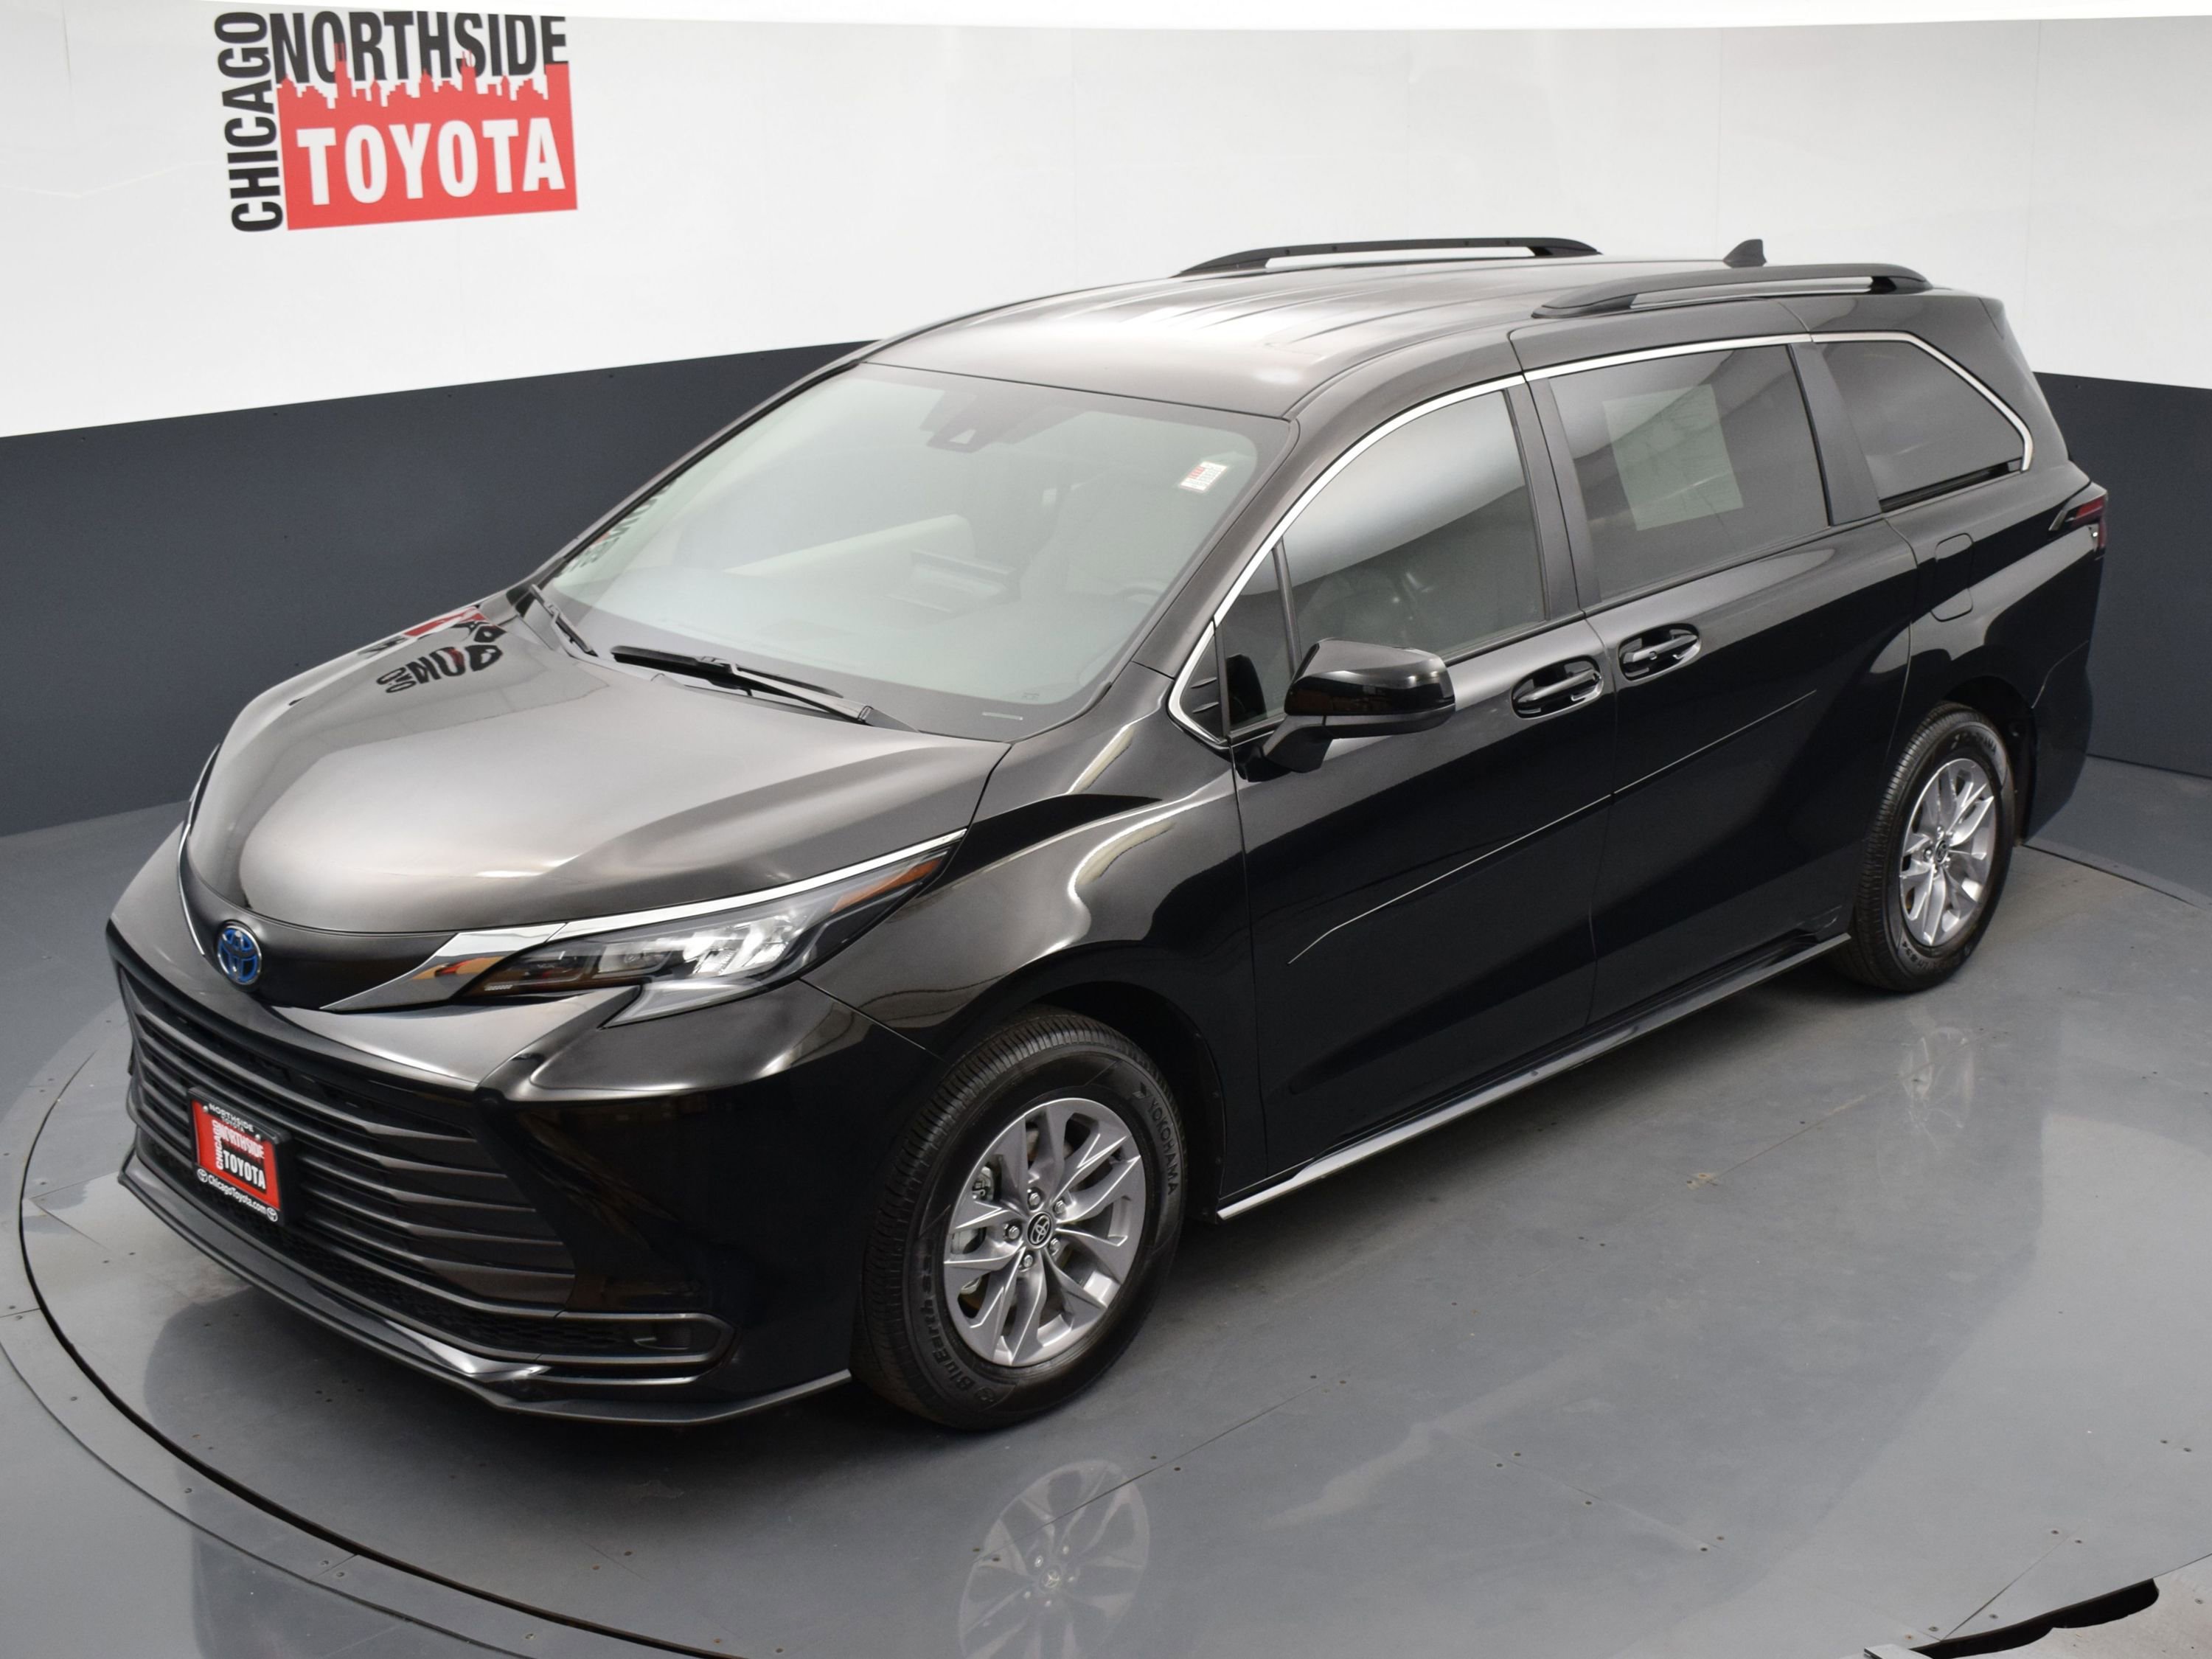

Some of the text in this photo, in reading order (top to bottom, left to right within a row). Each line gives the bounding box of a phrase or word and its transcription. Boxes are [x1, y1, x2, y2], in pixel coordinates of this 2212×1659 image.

[269, 10, 568, 84] NORTHSIDE
[215, 11, 284, 232] CHICAGO
[296, 117, 566, 206] TOYOTA
[209, 1103, 254, 1133] NORTHSIDE
[219, 1122, 265, 1160] NORTHSIDE
[212, 1119, 224, 1171] CHICAGO
[223, 1150, 266, 1190] TOYOTA
[1147, 1096, 1179, 1196] YOKOHAMA
[208, 1175, 268, 1215] ChicagoToyota.com
